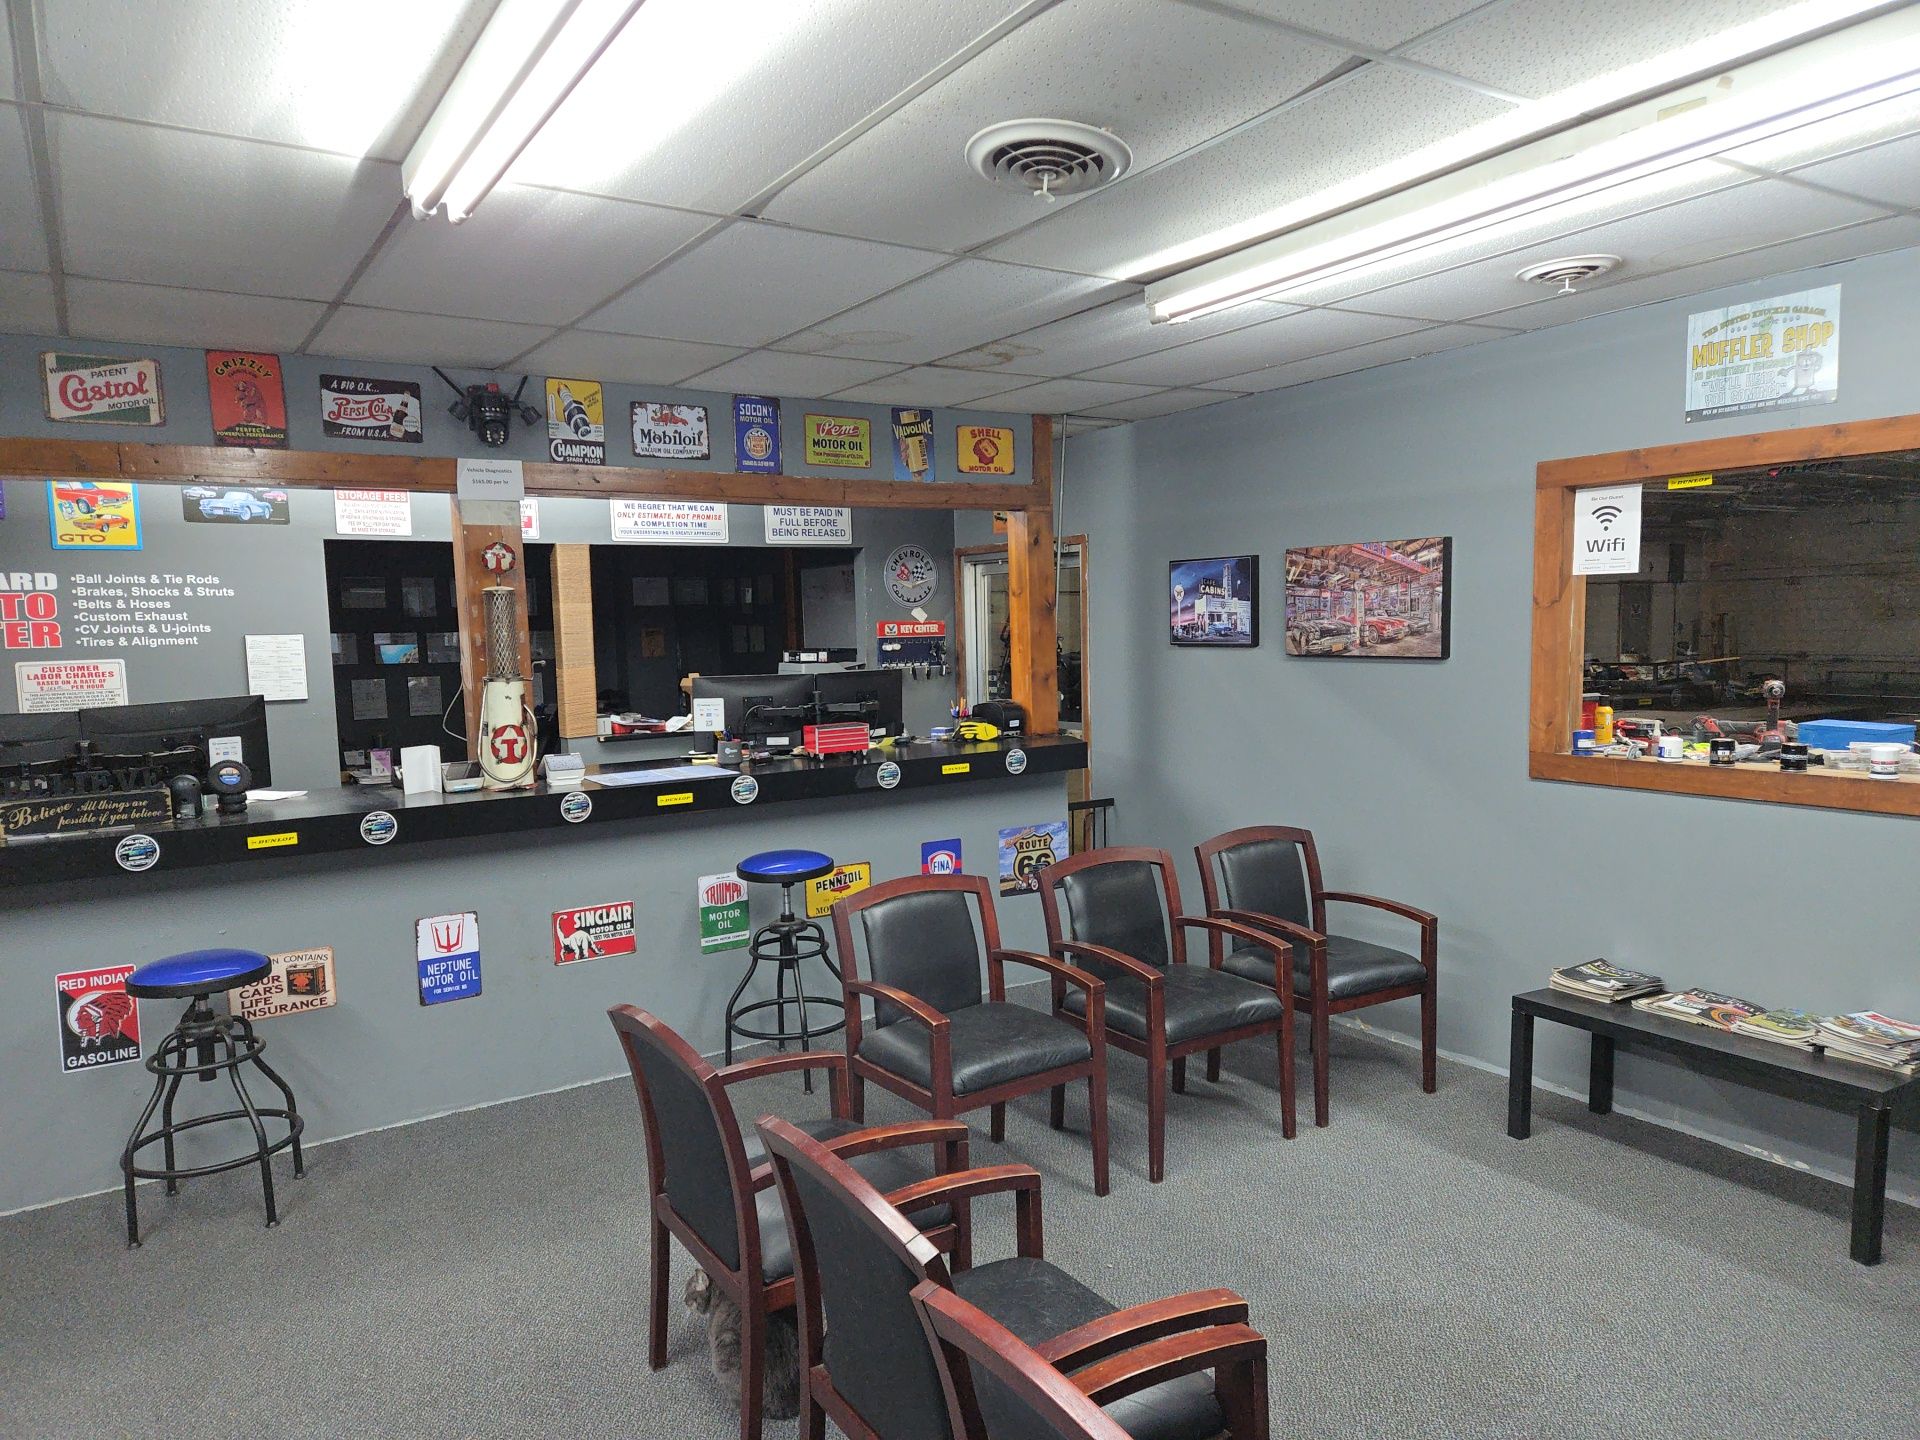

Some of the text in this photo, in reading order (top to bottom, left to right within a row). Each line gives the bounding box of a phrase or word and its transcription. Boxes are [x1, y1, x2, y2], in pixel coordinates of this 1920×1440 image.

[1692, 332, 1774, 370] MUFFLER
[1782, 321, 1834, 353] SHOP
[91, 367, 128, 378] PATENT
[215, 358, 272, 377] GRIZZLY
[331, 380, 338, 388] A
[59, 370, 148, 412] Castrol
[108, 400, 140, 410] MOTOR
[740, 404, 773, 416] SOCONY
[740, 416, 762, 424] MOTOR
[368, 429, 390, 438] U.S.A.
[892, 418, 933, 440] VALVOLINE
[970, 428, 1002, 440] SHELL
[640, 428, 704, 446] Mobiloil
[550, 439, 604, 462] CHAMPION
[812, 438, 862, 452] MOTOR OIL
[1677, 476, 1711, 485] DUNLOP
[338, 490, 407, 502] STORAGE FEES
[773, 508, 843, 517] MUST BE PAID IN
[780, 518, 838, 527] FULL BEFORE
[60, 533, 106, 543] GTO
[772, 528, 846, 537] BEING RELEASED
[1586, 538, 1626, 552] Wifi
[890, 550, 932, 572] CHEVROLET
[76, 574, 220, 584] Ball Joints & Tie Rods
[77, 586, 234, 598] Brakes, Shocks & Struts
[1200, 584, 1225, 596] CABINS
[78, 600, 171, 610] Belts & Hoses
[79, 612, 188, 622] Custom Exhaust
[80, 624, 212, 635] CV Joints & U-joints
[900, 624, 938, 634] KEY CENTER
[80, 636, 199, 648] Tires & Alignment
[42, 665, 100, 673] CUSTOMER
[66, 671, 114, 679] CHARGES
[8, 802, 74, 830] Believe
[77, 801, 97, 812] All
[98, 800, 129, 812] things
[57, 808, 162, 830] possible if you believe
[258, 836, 295, 844] DUNLOP
[1018, 838, 1048, 850] ROUTE
[933, 862, 950, 873] FINA
[816, 870, 863, 893] PENNZOIL
[705, 882, 742, 906] TRIUMPH
[574, 905, 632, 929] SINCLAIR
[708, 909, 740, 922] MOTOR
[590, 922, 630, 934] MOTOR OILS
[718, 920, 733, 930] OIL
[284, 954, 329, 963] CONTAINS
[427, 958, 472, 976] NEPTUNE
[60, 978, 86, 991] RED
[242, 975, 282, 989] OUR
[422, 973, 454, 988] MOTOR
[460, 970, 478, 982] OIL
[239, 984, 284, 999] CAR'S
[240, 996, 274, 1010] LIFE
[242, 997, 328, 1018] INSURANCE
[66, 1046, 138, 1068] GASOLINE
